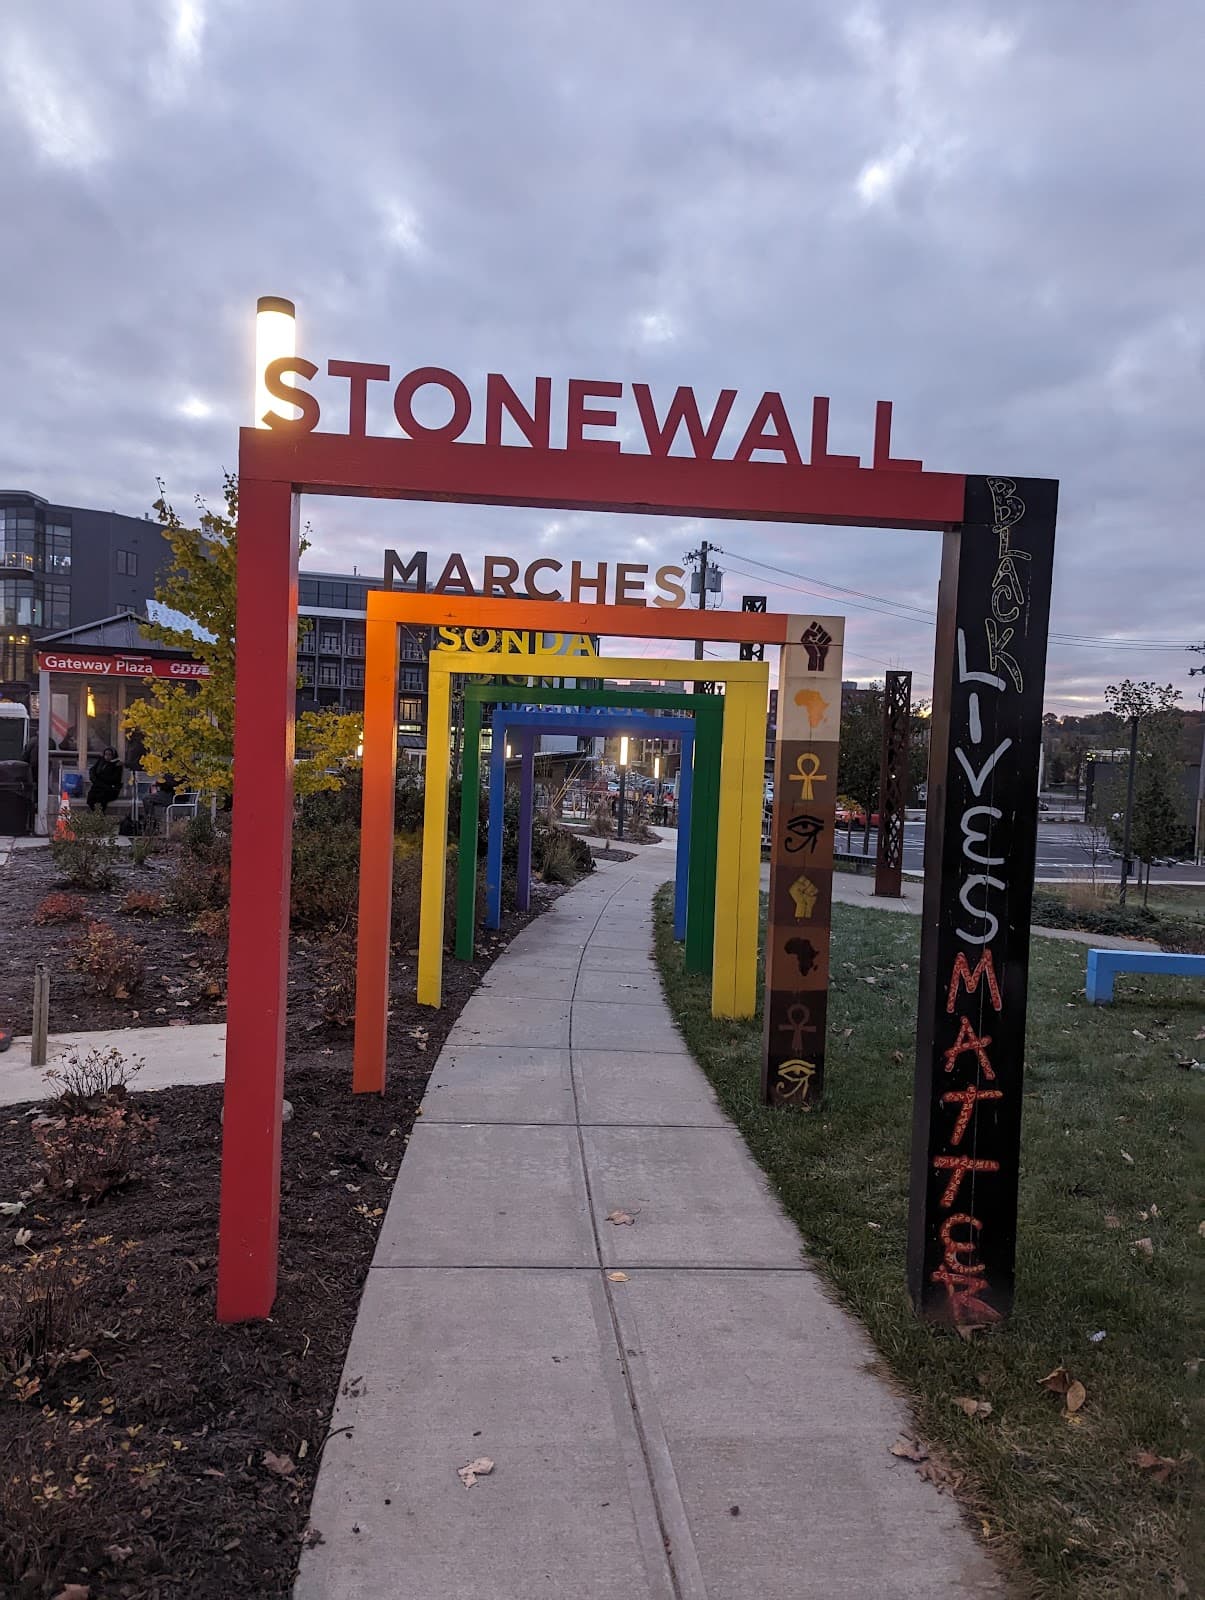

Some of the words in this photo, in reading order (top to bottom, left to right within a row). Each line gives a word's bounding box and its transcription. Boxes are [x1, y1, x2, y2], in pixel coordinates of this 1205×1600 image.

[260, 356, 923, 472] STONEWALL
[384, 549, 687, 609] MARCHES
[985, 476, 1032, 693] BLACK
[45, 655, 112, 674] Gateway
[116, 660, 153, 674] Plaza
[437, 626, 596, 656] SONDA
[955, 627, 1013, 945] LIVES
